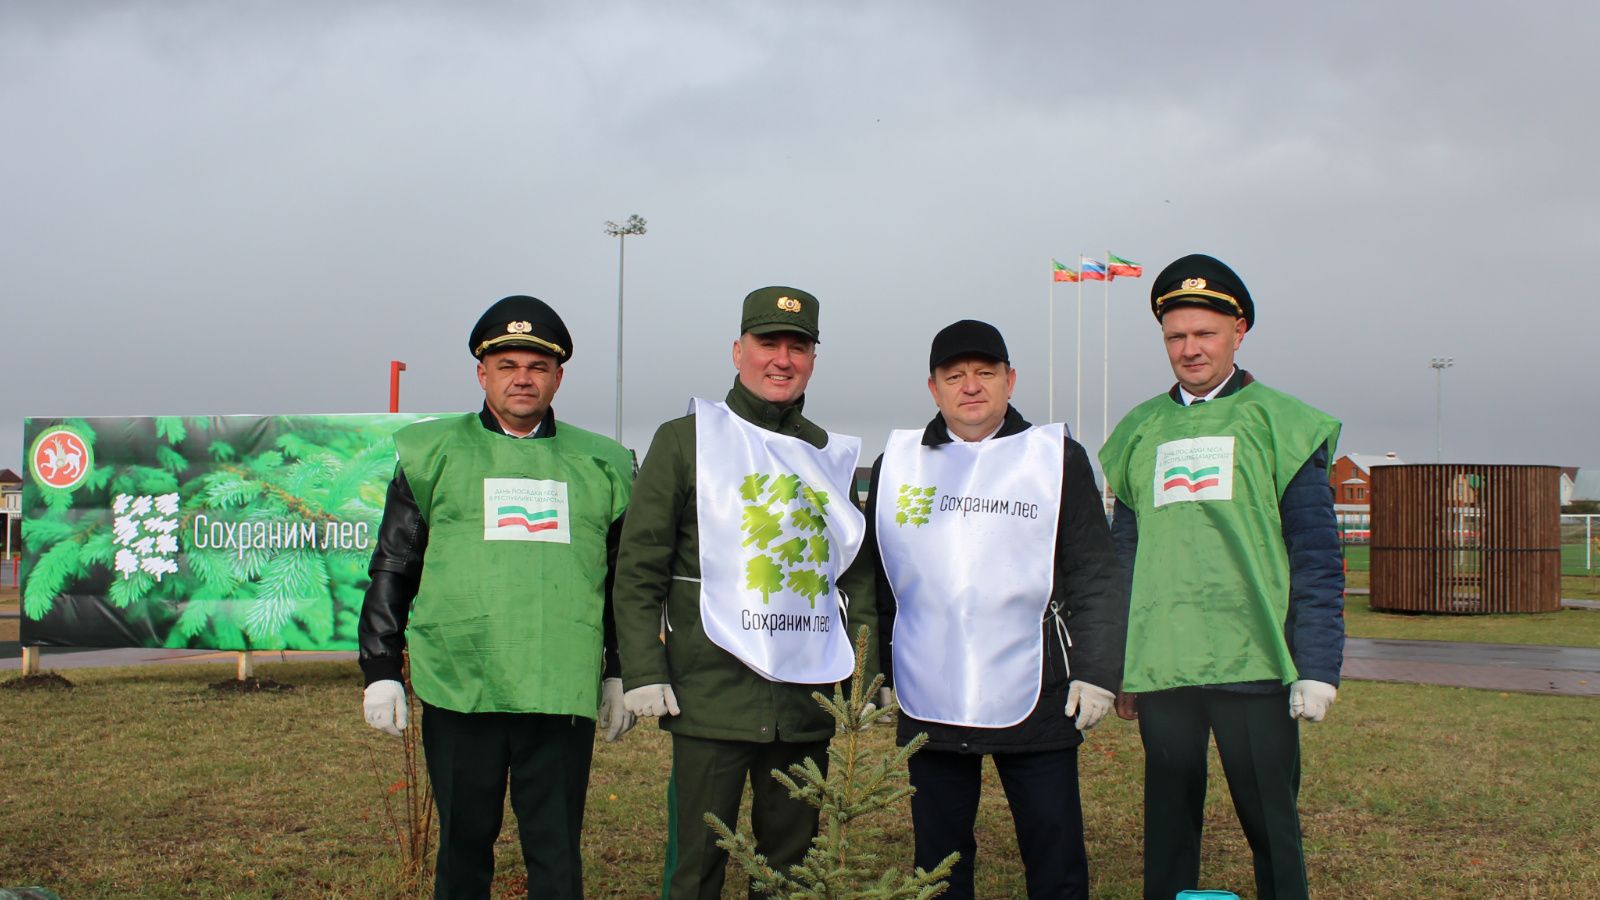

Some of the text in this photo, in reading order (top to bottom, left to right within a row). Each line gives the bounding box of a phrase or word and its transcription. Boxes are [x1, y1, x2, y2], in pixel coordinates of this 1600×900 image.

[939, 494, 1038, 519] Сохраним лес
[194, 514, 368, 560] Сохраним лес
[741, 609, 830, 637] Сохраним лес
